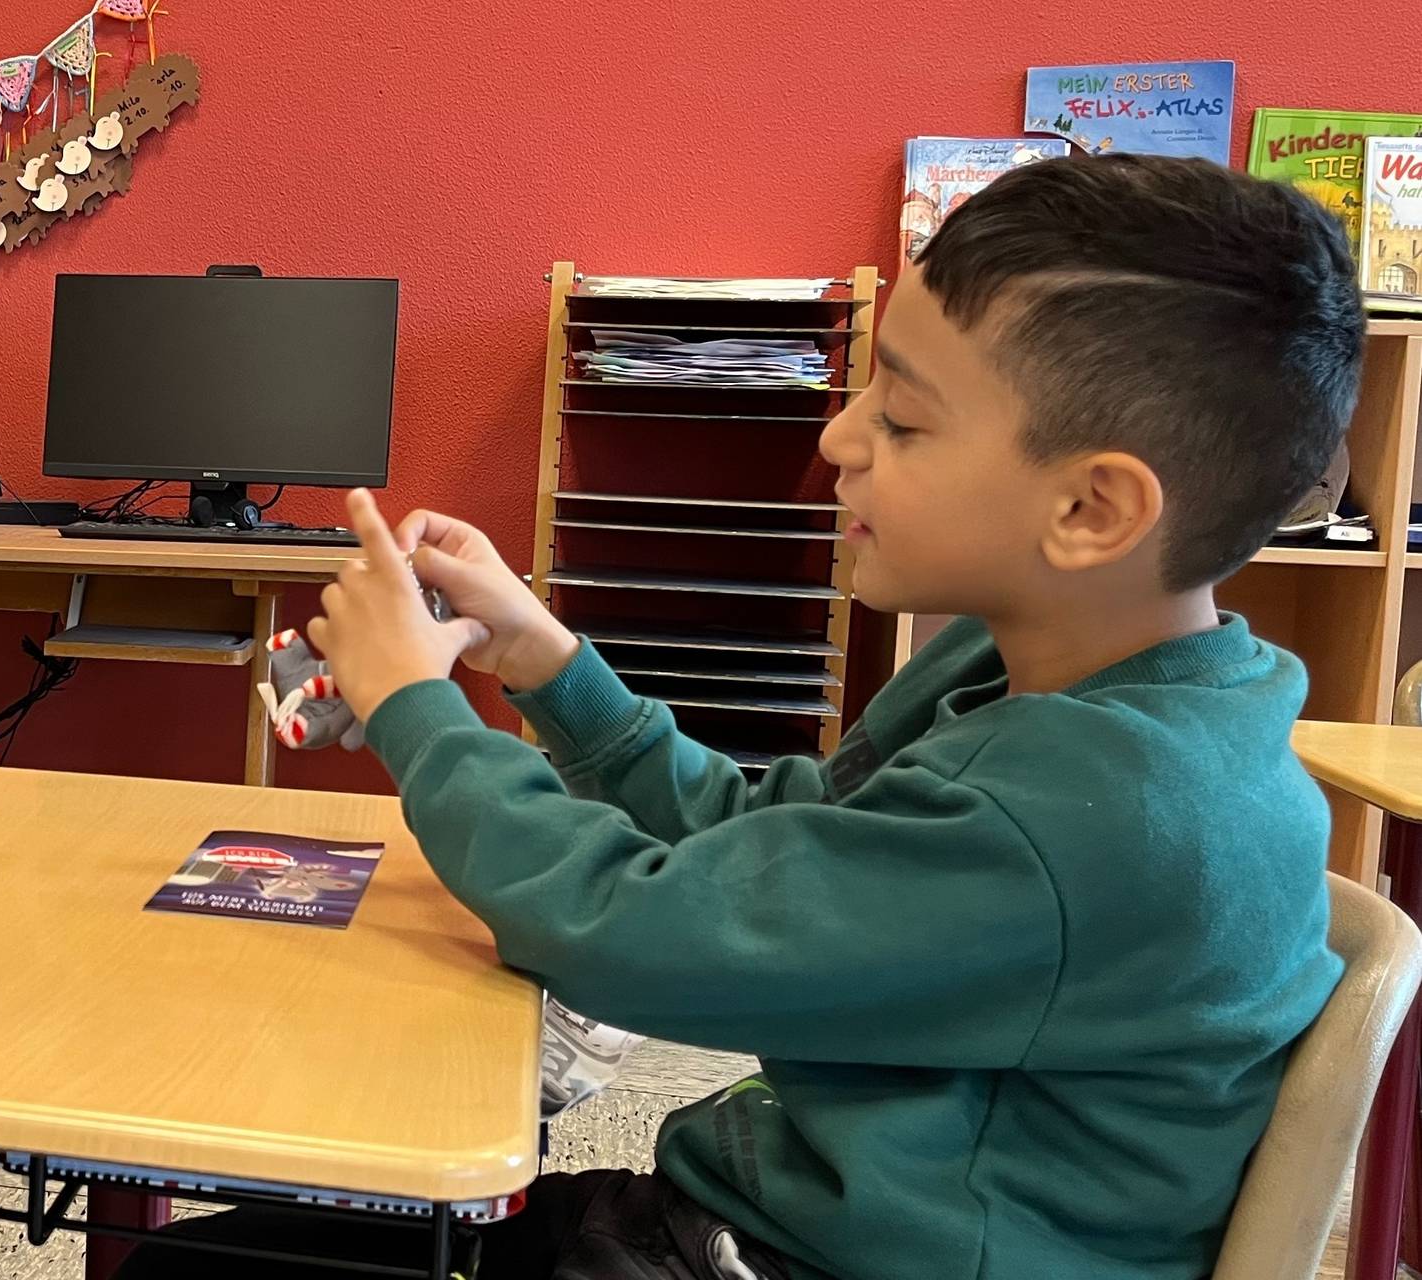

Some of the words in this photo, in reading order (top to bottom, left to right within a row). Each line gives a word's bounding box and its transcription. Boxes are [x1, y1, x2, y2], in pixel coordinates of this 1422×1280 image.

[151, 69, 175, 85] arla
[1113, 72, 1195, 93] ERSTER
[117, 96, 140, 112] Milo
[1268, 126, 1364, 162] Kinder
